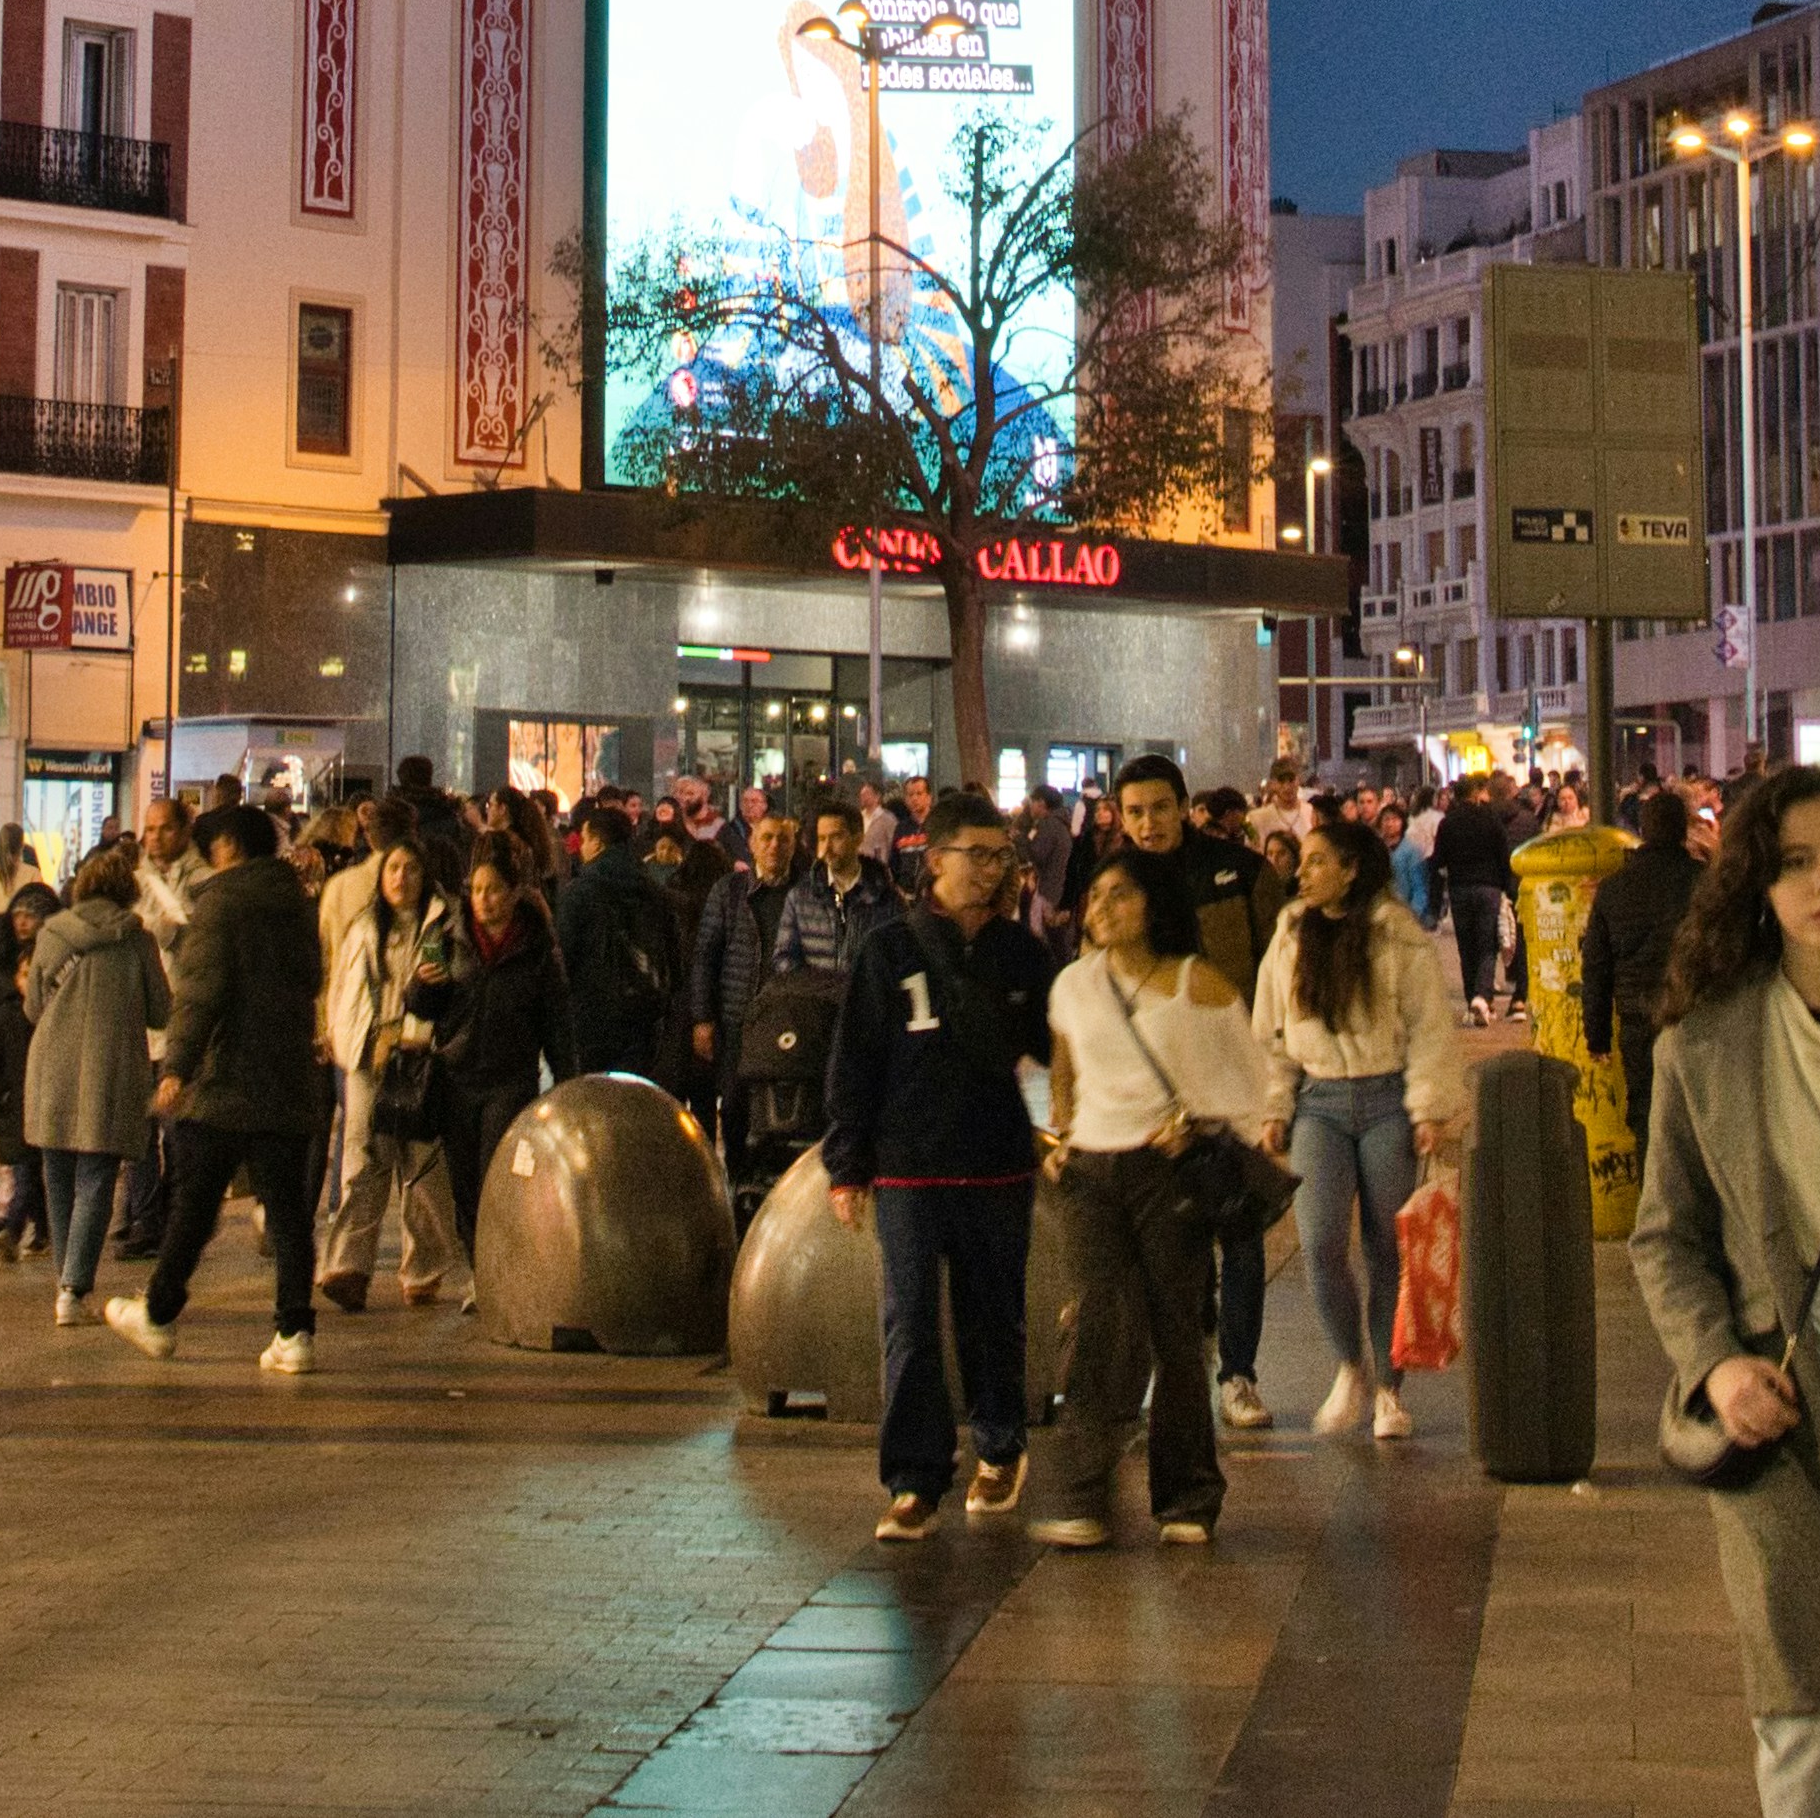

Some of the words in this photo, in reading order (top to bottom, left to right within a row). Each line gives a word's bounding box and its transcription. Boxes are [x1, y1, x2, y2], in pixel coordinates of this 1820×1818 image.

[980, 1, 1020, 30] que
[956, 33, 985, 58] en
[1639, 520, 1688, 539] TEVA
[978, 537, 1121, 587] CALLAO
[45, 758, 85, 774] Western
[85, 761, 111, 775] Union
[899, 971, 940, 1033] 1
